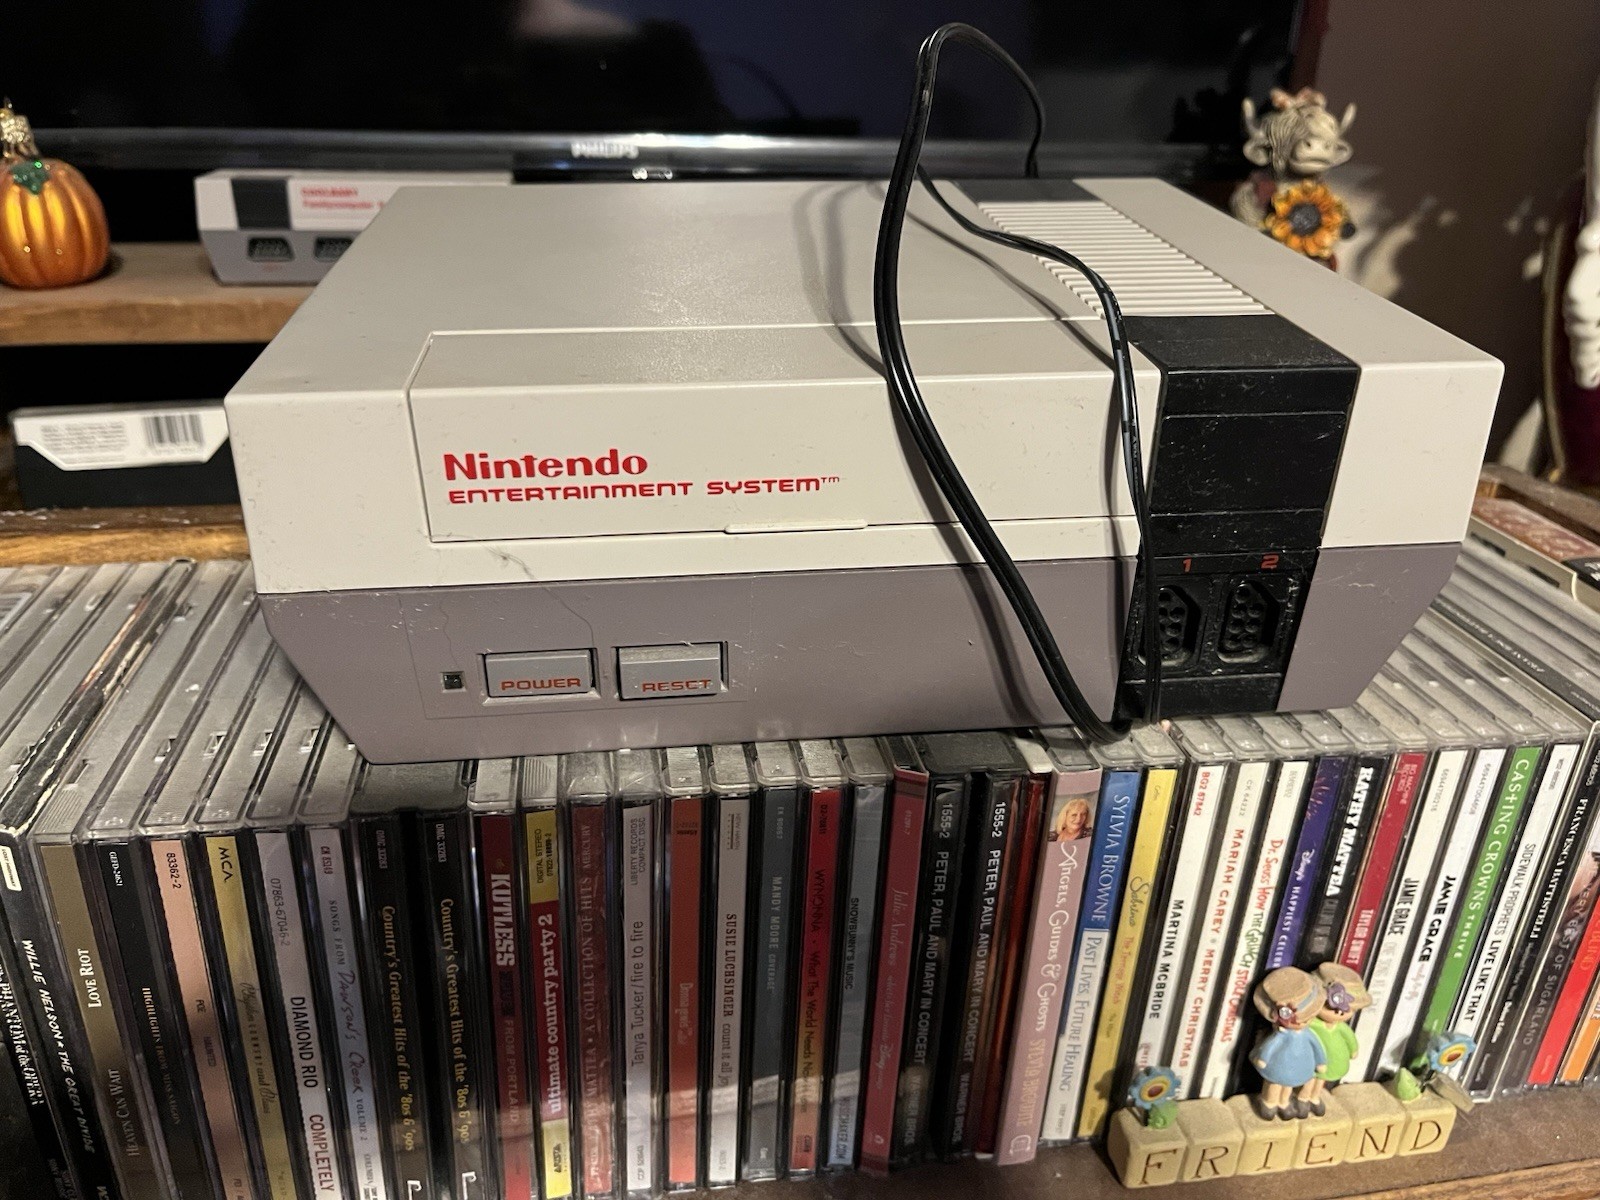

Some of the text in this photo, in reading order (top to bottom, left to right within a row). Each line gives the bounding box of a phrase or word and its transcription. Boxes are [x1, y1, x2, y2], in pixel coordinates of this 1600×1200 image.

[443, 448, 649, 481] Nintendo
[448, 481, 694, 505] ENTERTAINMENT
[1182, 557, 1192, 573] 1
[1260, 554, 1280, 570] 2
[500, 676, 582, 692] POWER
[641, 678, 713, 693] RESET
[1198, 771, 1210, 790] BG2
[938, 802, 954, 839] 1555-2
[1325, 766, 1375, 897] KATHY MATTEA
[1555, 797, 1589, 867] FRANCESCA
[166, 852, 182, 889] 83362-2
[219, 846, 233, 882] MCA
[629, 818, 640, 886] LIBERTY RECORDS
[1090, 794, 1131, 923] SYLVIA BROWNE
[1259, 856, 1279, 885] Seuss
[1268, 838, 1284, 855] Dr.
[1452, 758, 1530, 959] CASTING CROWNS THRIVE
[580, 877, 593, 910] HITS
[770, 876, 784, 912] MANDY
[930, 850, 950, 896] PETER,
[270, 877, 290, 947] 07863-67046-2
[490, 873, 516, 967] KUTLESS
[581, 915, 594, 933] OF
[890, 888, 909, 916] Julie
[928, 898, 945, 931] PAUL
[1129, 876, 1150, 928] Sabrina
[1251, 911, 1264, 928] THE
[1281, 885, 1302, 932] HAPPIEST
[1387, 877, 1420, 937] JAMIE GRACE
[1418, 875, 1457, 963] JAMIE GRACE
[1528, 867, 1564, 939] BATTISTELLI
[381, 905, 401, 968] Country's
[439, 898, 459, 962] Country's
[768, 915, 781, 949] MOORE
[844, 897, 860, 990] SNOWBUNNY'S MUSIC
[888, 917, 907, 966] Andrews
[925, 933, 940, 960] AND
[1046, 910, 1069, 961] GUIDES
[1086, 936, 1103, 962] PAST
[1179, 828, 1244, 1068] MARIAH CAREY MERRY CHRISTMAS
[1238, 927, 1266, 969] GRINCH
[1345, 908, 1374, 965] TAYLOR SWIFT
[1463, 842, 1537, 1022] SIDEWALK PROPHETS LIVE LIKE THAT
[77, 948, 102, 1008] LOVE RIOT
[582, 939, 596, 1016] COLLECTION
[802, 868, 826, 1059] WYNONNA What The World Needs
[921, 961, 937, 996] MARY
[956, 801, 1007, 1114] 1555-2 PETER, PAUL AND MARY IN CONCERT WARNER
[1149, 899, 1184, 1020] MARTINA MCBRIDE
[1552, 953, 1566, 971] OF
[389, 970, 405, 1024] Greatest
[445, 963, 461, 1018] Greatest
[537, 913, 563, 1115] ultimate country party 2
[630, 921, 646, 1068] Tanya to fire
[719, 913, 738, 1074] SUSIE LUCHSINGER count all
[920, 997, 933, 1010] IN
[1035, 982, 1058, 1032] GHOSTS
[1522, 973, 1558, 1046] SUGARLAND
[328, 899, 367, 1134] SONGS FROM VOLUME
[394, 1027, 407, 1052] Hits
[451, 1019, 464, 1045] Hits
[504, 1019, 516, 1053] FROM
[914, 1011, 931, 1064] CONCERT
[1067, 999, 1090, 1042] FUTURE
[22, 939, 95, 1154] WILLIE NELSON THE GREAT DIVIDE
[141, 987, 181, 1125] HIGHLIGHTS FROM SAIGON
[290, 996, 318, 1089] DIAMOND RIO
[396, 1054, 410, 1069] of
[454, 1047, 467, 1061] of
[1059, 1043, 1081, 1092] HEALING
[398, 1070, 412, 1090] the
[455, 1062, 468, 1083] the
[507, 1057, 520, 1123] PORTLAND
[108, 1068, 140, 1157] HEAVEN CAN WAIT
[309, 1113, 335, 1192] COMPLETELY
[1138, 1119, 1442, 1186] FRIEND
